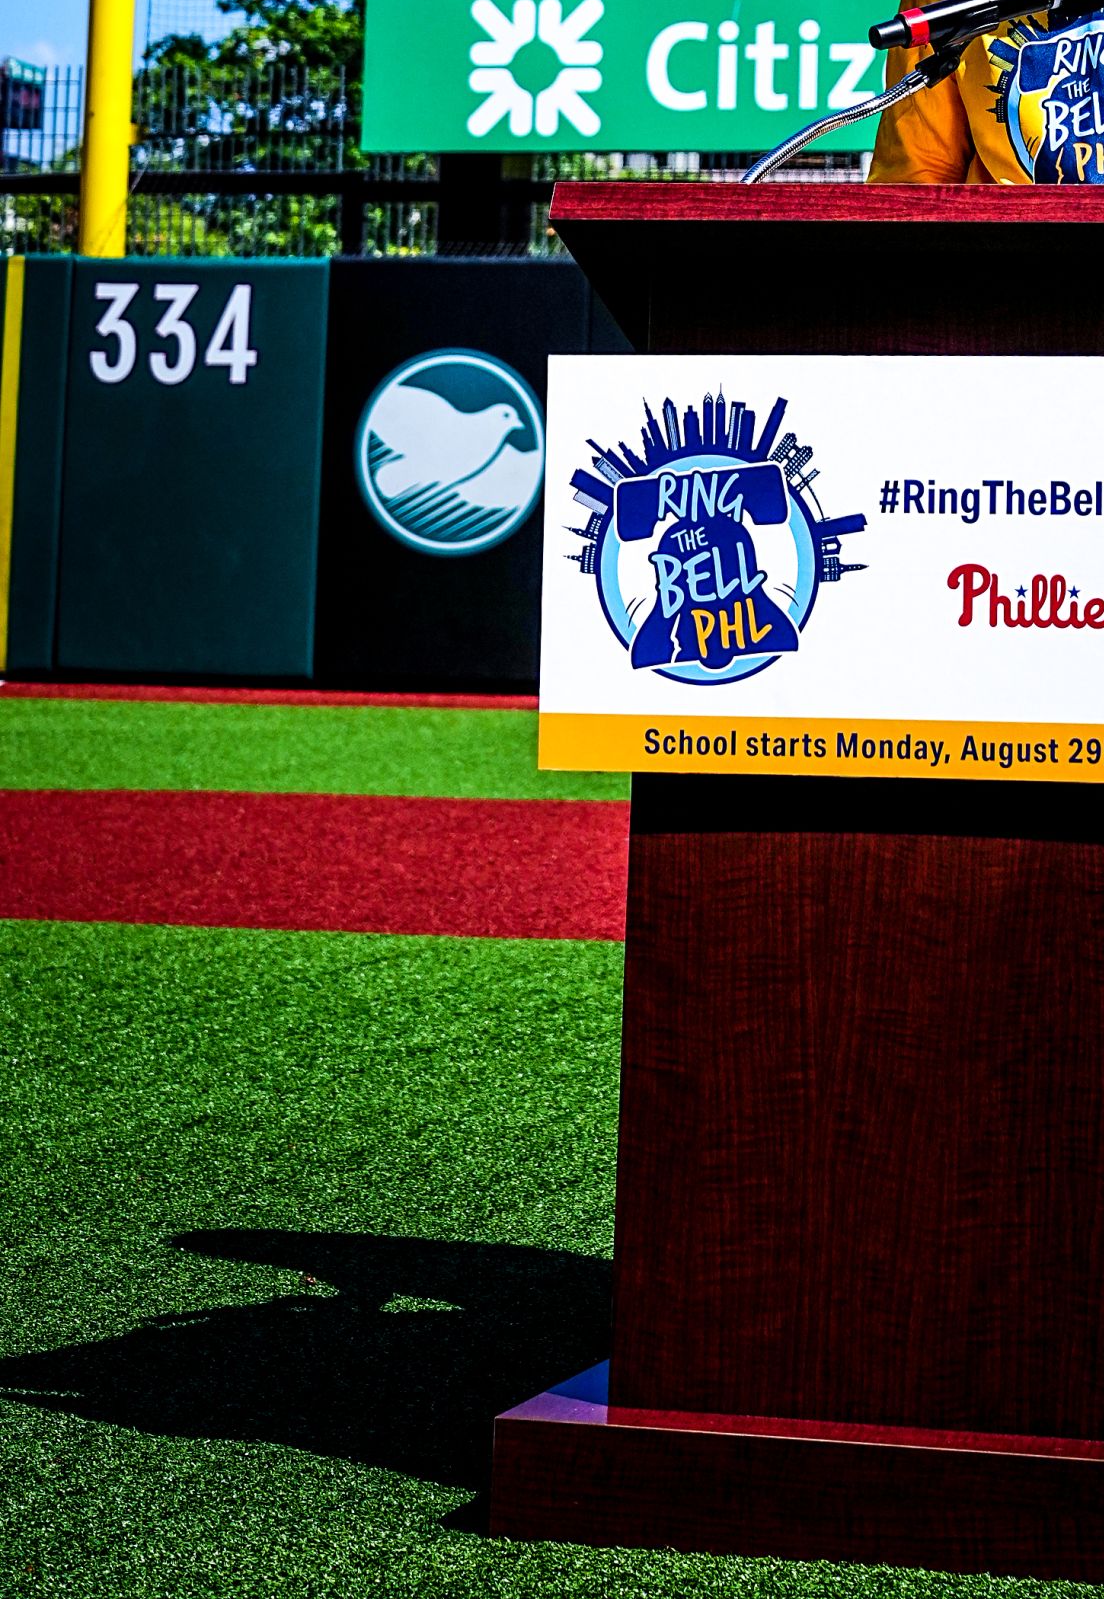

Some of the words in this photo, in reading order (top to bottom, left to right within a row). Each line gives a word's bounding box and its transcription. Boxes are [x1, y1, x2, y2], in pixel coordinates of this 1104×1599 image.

[646, 19, 888, 112] Citiz
[1061, 77, 1091, 100] THE
[89, 282, 258, 385] 334
[657, 472, 744, 523] RING
[670, 526, 709, 553] THE
[651, 541, 766, 619] BELL
[690, 597, 773, 659] PHL
[644, 728, 738, 757] School
[745, 732, 827, 759] starts
[836, 732, 952, 767] Monday,
[960, 734, 1059, 769] August
